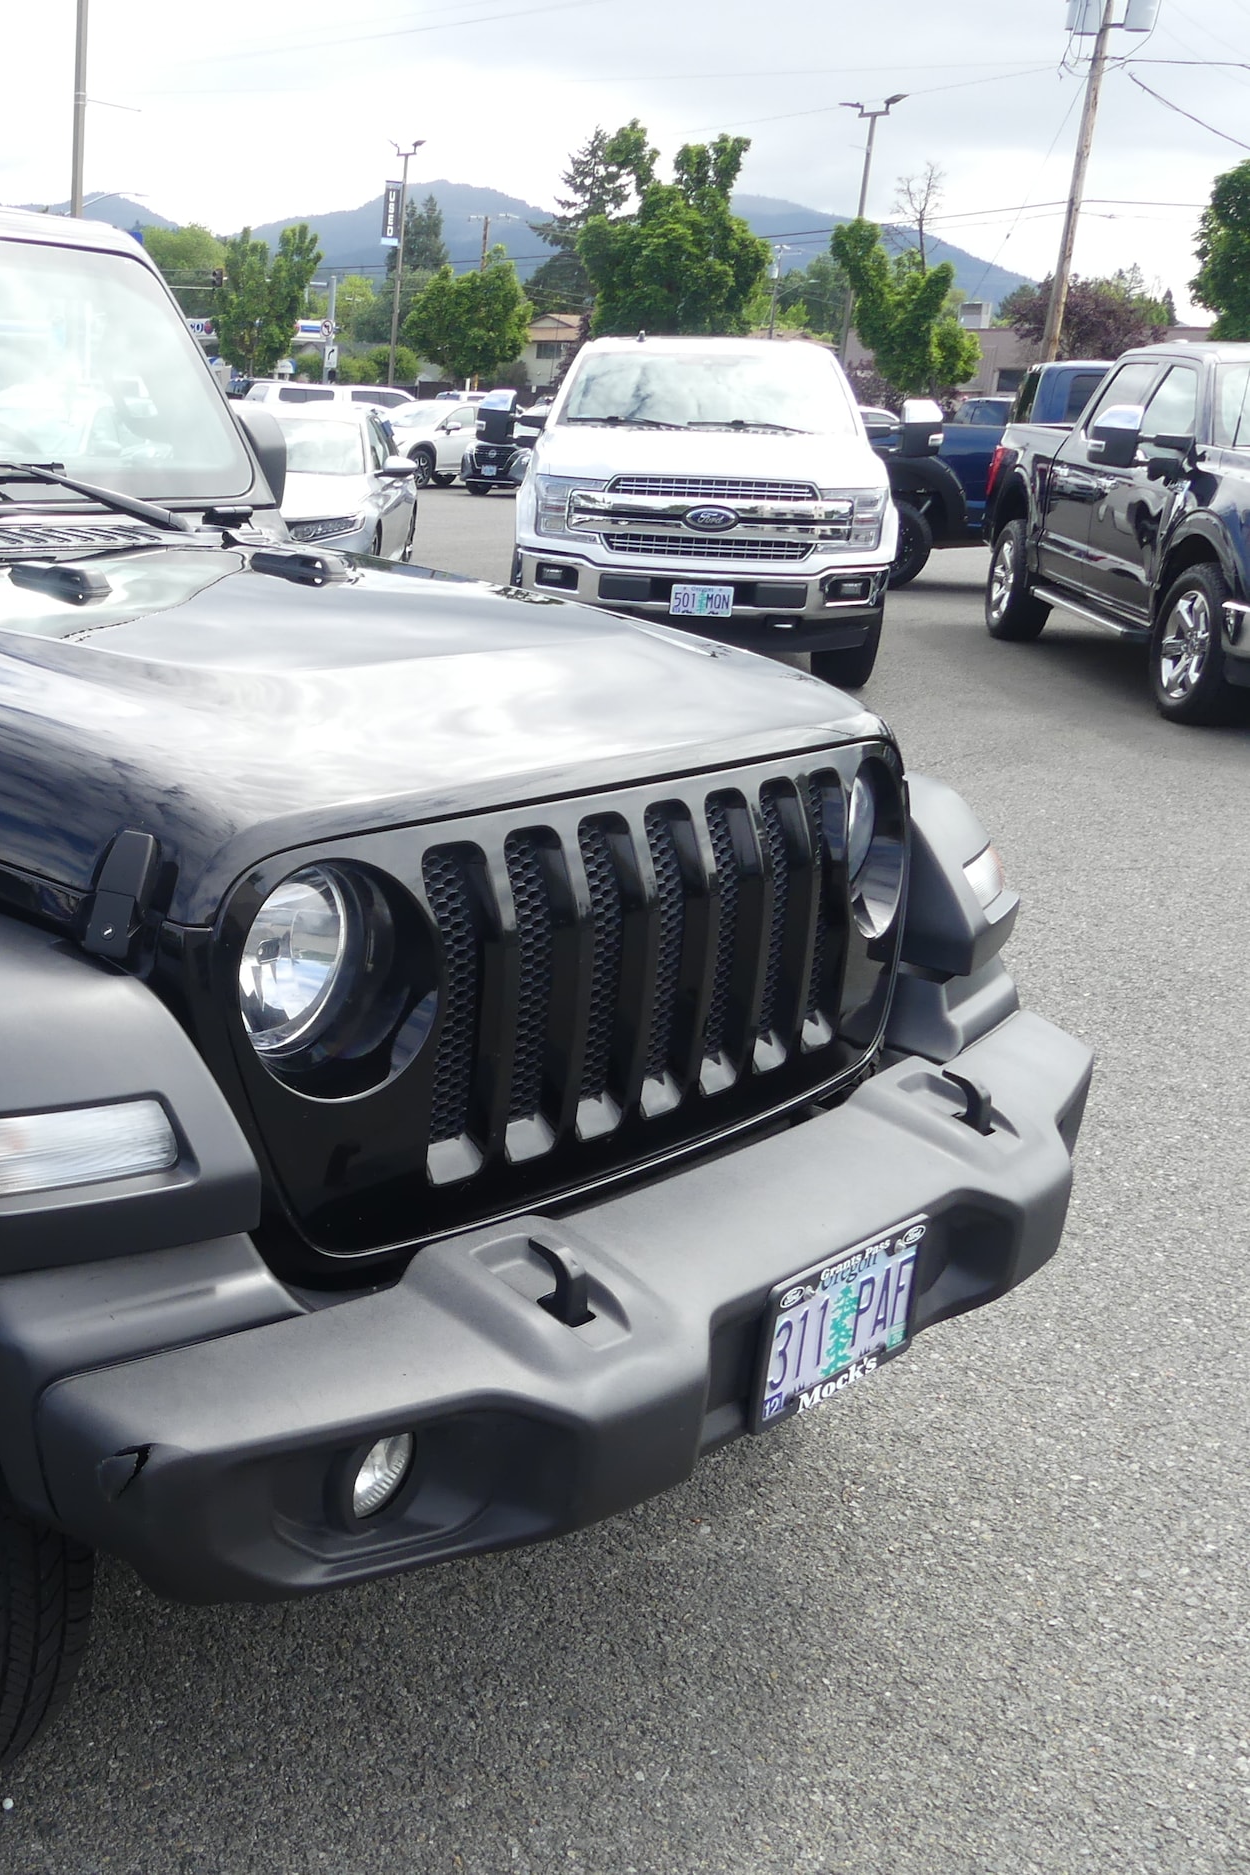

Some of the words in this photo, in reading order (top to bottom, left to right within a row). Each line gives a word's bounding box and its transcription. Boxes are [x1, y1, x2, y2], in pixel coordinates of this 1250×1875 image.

[387, 190, 395, 237] USED
[697, 511, 725, 524] Ford
[674, 592, 696, 608] 501
[820, 1253, 863, 1281] Grants
[864, 1239, 891, 1259] Pass
[768, 1297, 830, 1392] 311
[850, 1255, 915, 1348] PAF
[797, 1356, 877, 1414] Mock's
[764, 1397, 780, 1418] 12
